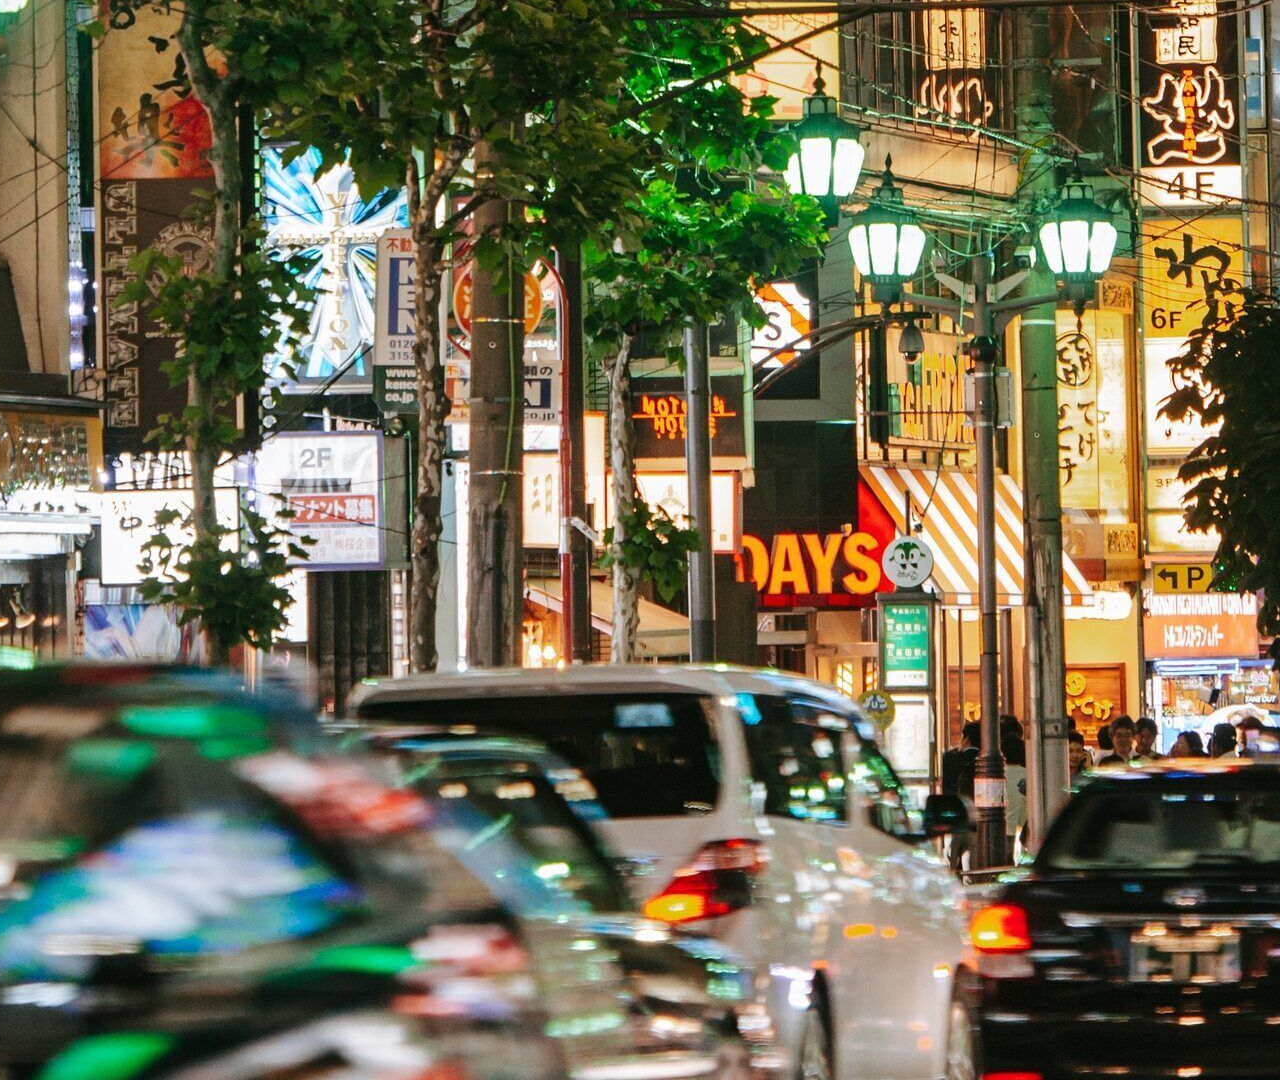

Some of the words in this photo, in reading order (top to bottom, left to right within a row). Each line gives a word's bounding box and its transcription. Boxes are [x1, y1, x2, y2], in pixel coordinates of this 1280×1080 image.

[1167, 171, 1215, 201] 4F
[386, 238, 413, 252] 不動
[1150, 308, 1182, 330] 6F
[389, 340, 417, 349] 0120
[523, 339, 558, 352] assage
[389, 352, 416, 361] 3152
[385, 370, 418, 380] www
[523, 365, 553, 377] 頼の
[385, 380, 419, 391] kenco
[385, 392, 415, 406] co.jp
[301, 448, 331, 468] 2F
[292, 499, 374, 521] テナント募集
[1188, 566, 1205, 589] P
